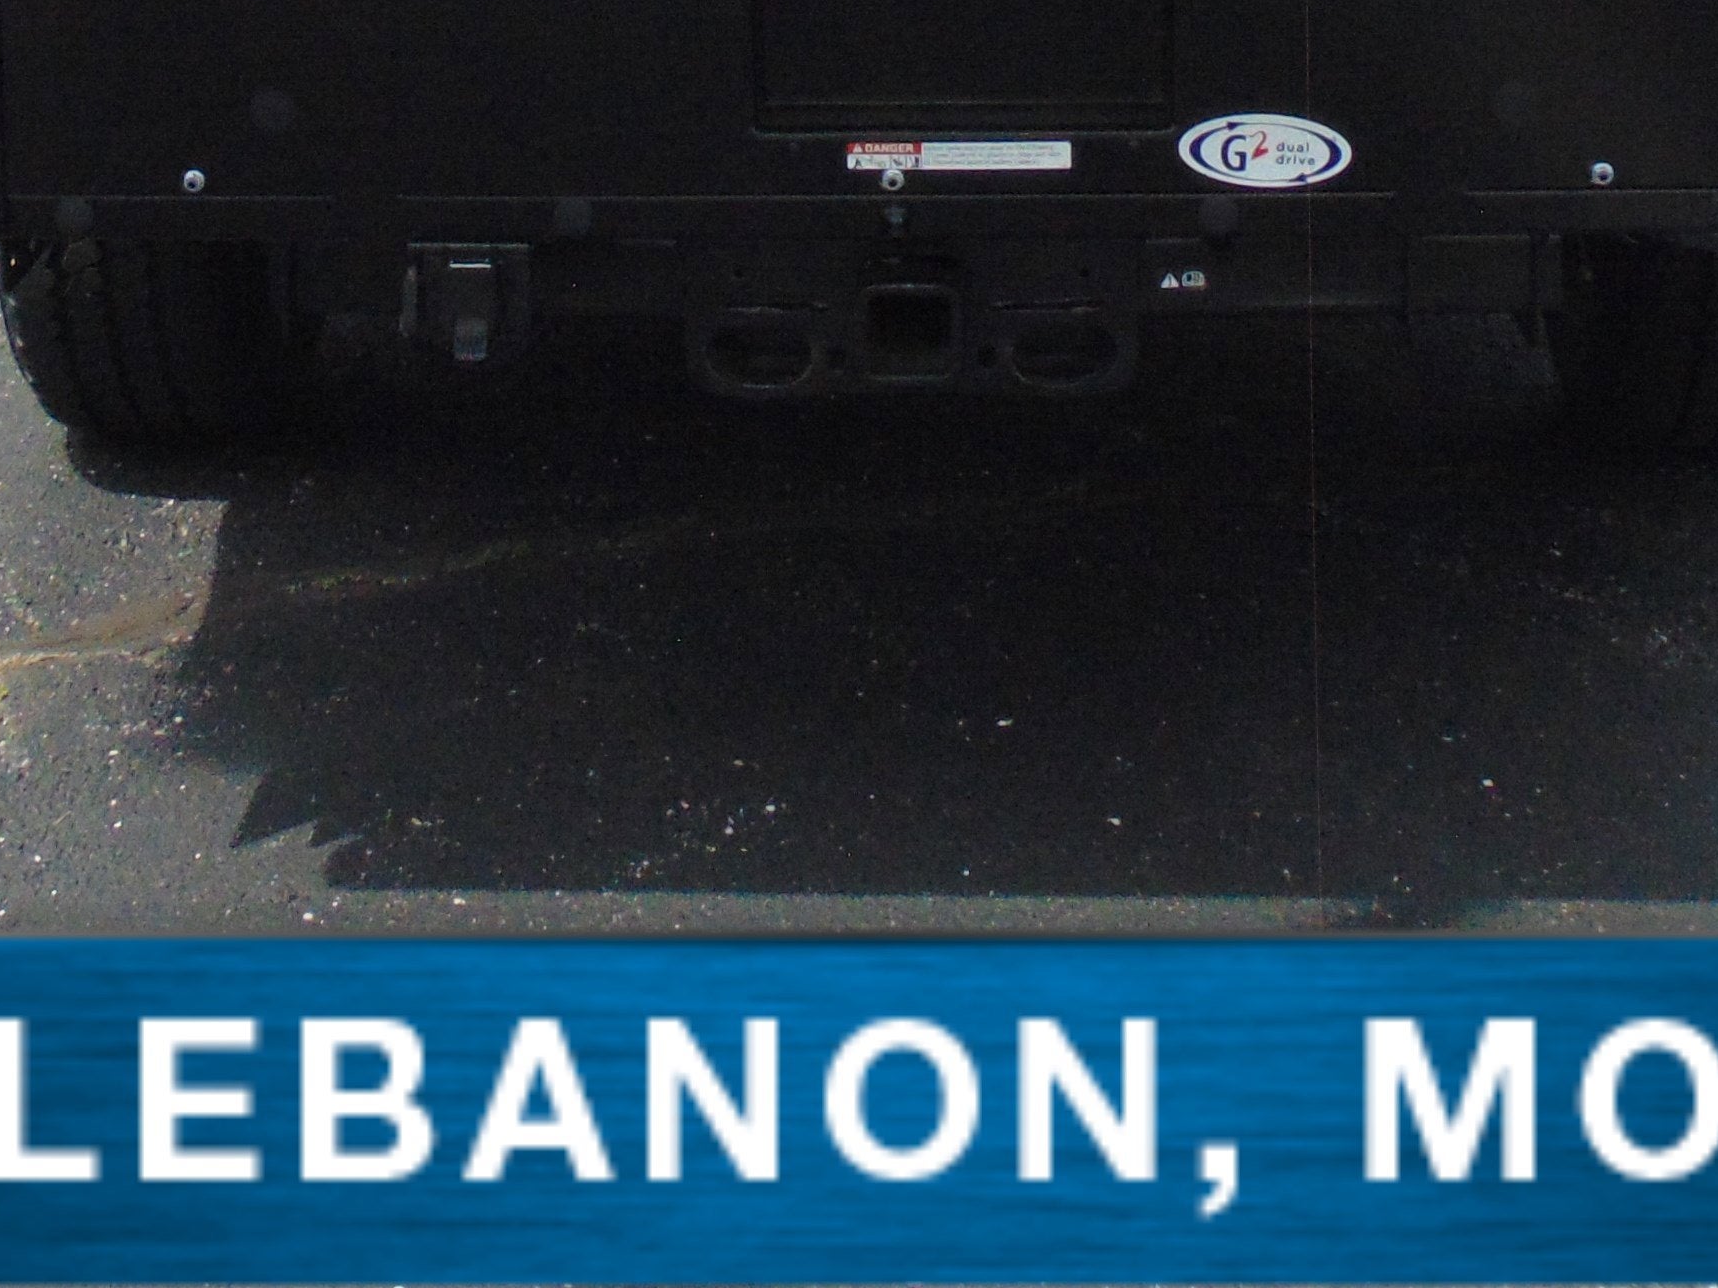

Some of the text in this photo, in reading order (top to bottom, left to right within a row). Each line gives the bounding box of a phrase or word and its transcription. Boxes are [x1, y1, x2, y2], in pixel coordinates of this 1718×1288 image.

[864, 143, 914, 153] DANGER
[1276, 142, 1310, 153] dual
[1276, 155, 1316, 166] drive
